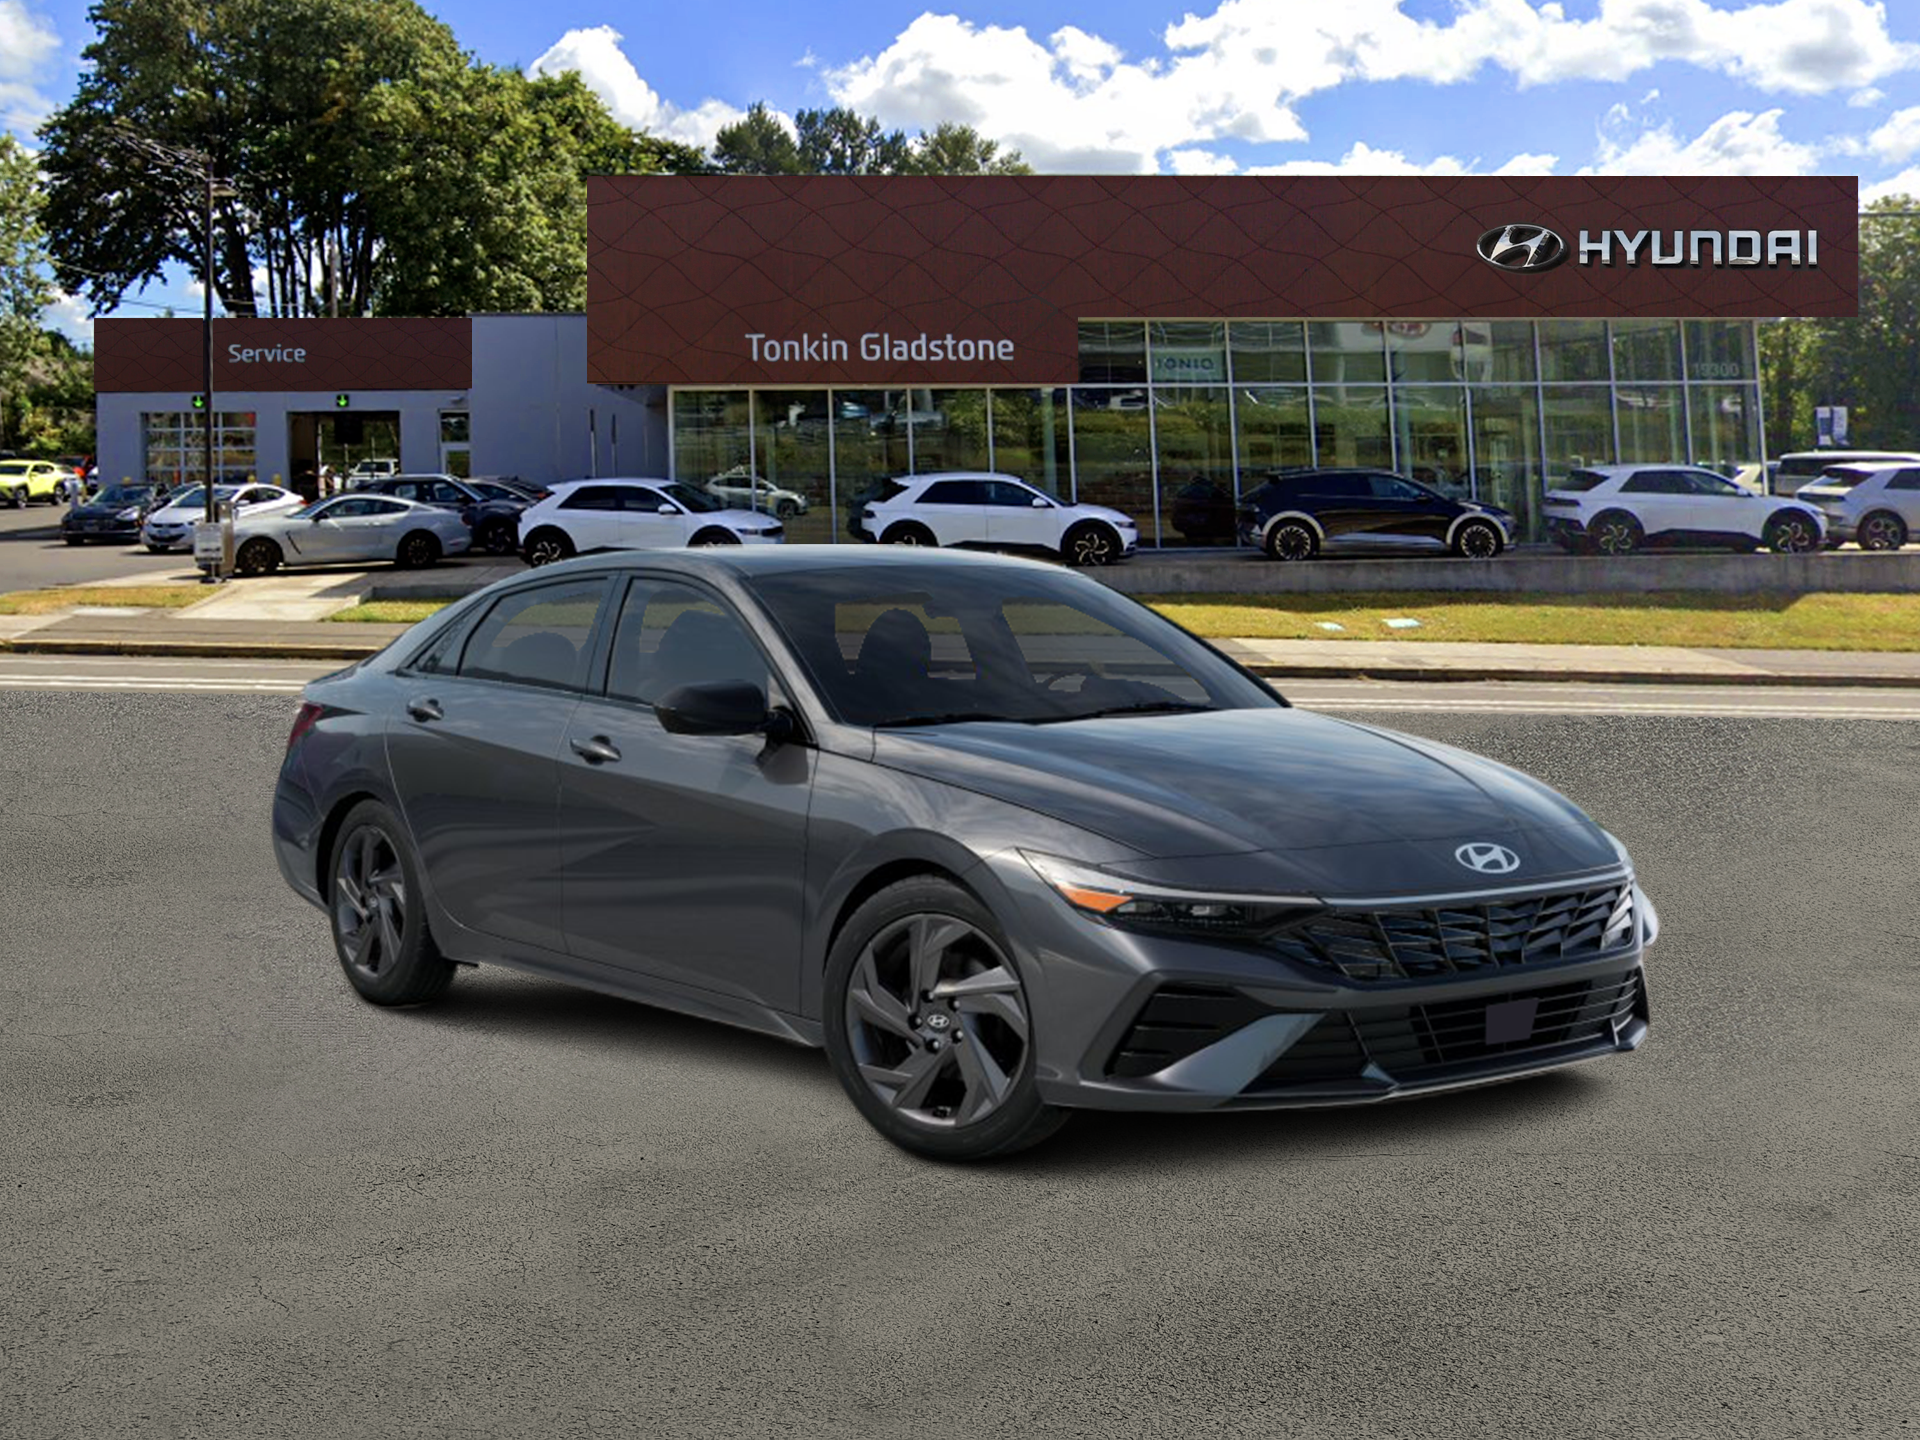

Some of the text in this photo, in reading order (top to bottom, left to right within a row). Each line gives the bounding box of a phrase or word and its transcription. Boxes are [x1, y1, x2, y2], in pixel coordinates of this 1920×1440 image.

[1579, 230, 1818, 265] HYUNDAI
[228, 343, 307, 363] Service
[745, 333, 1014, 362] Tonkin Gladstone
